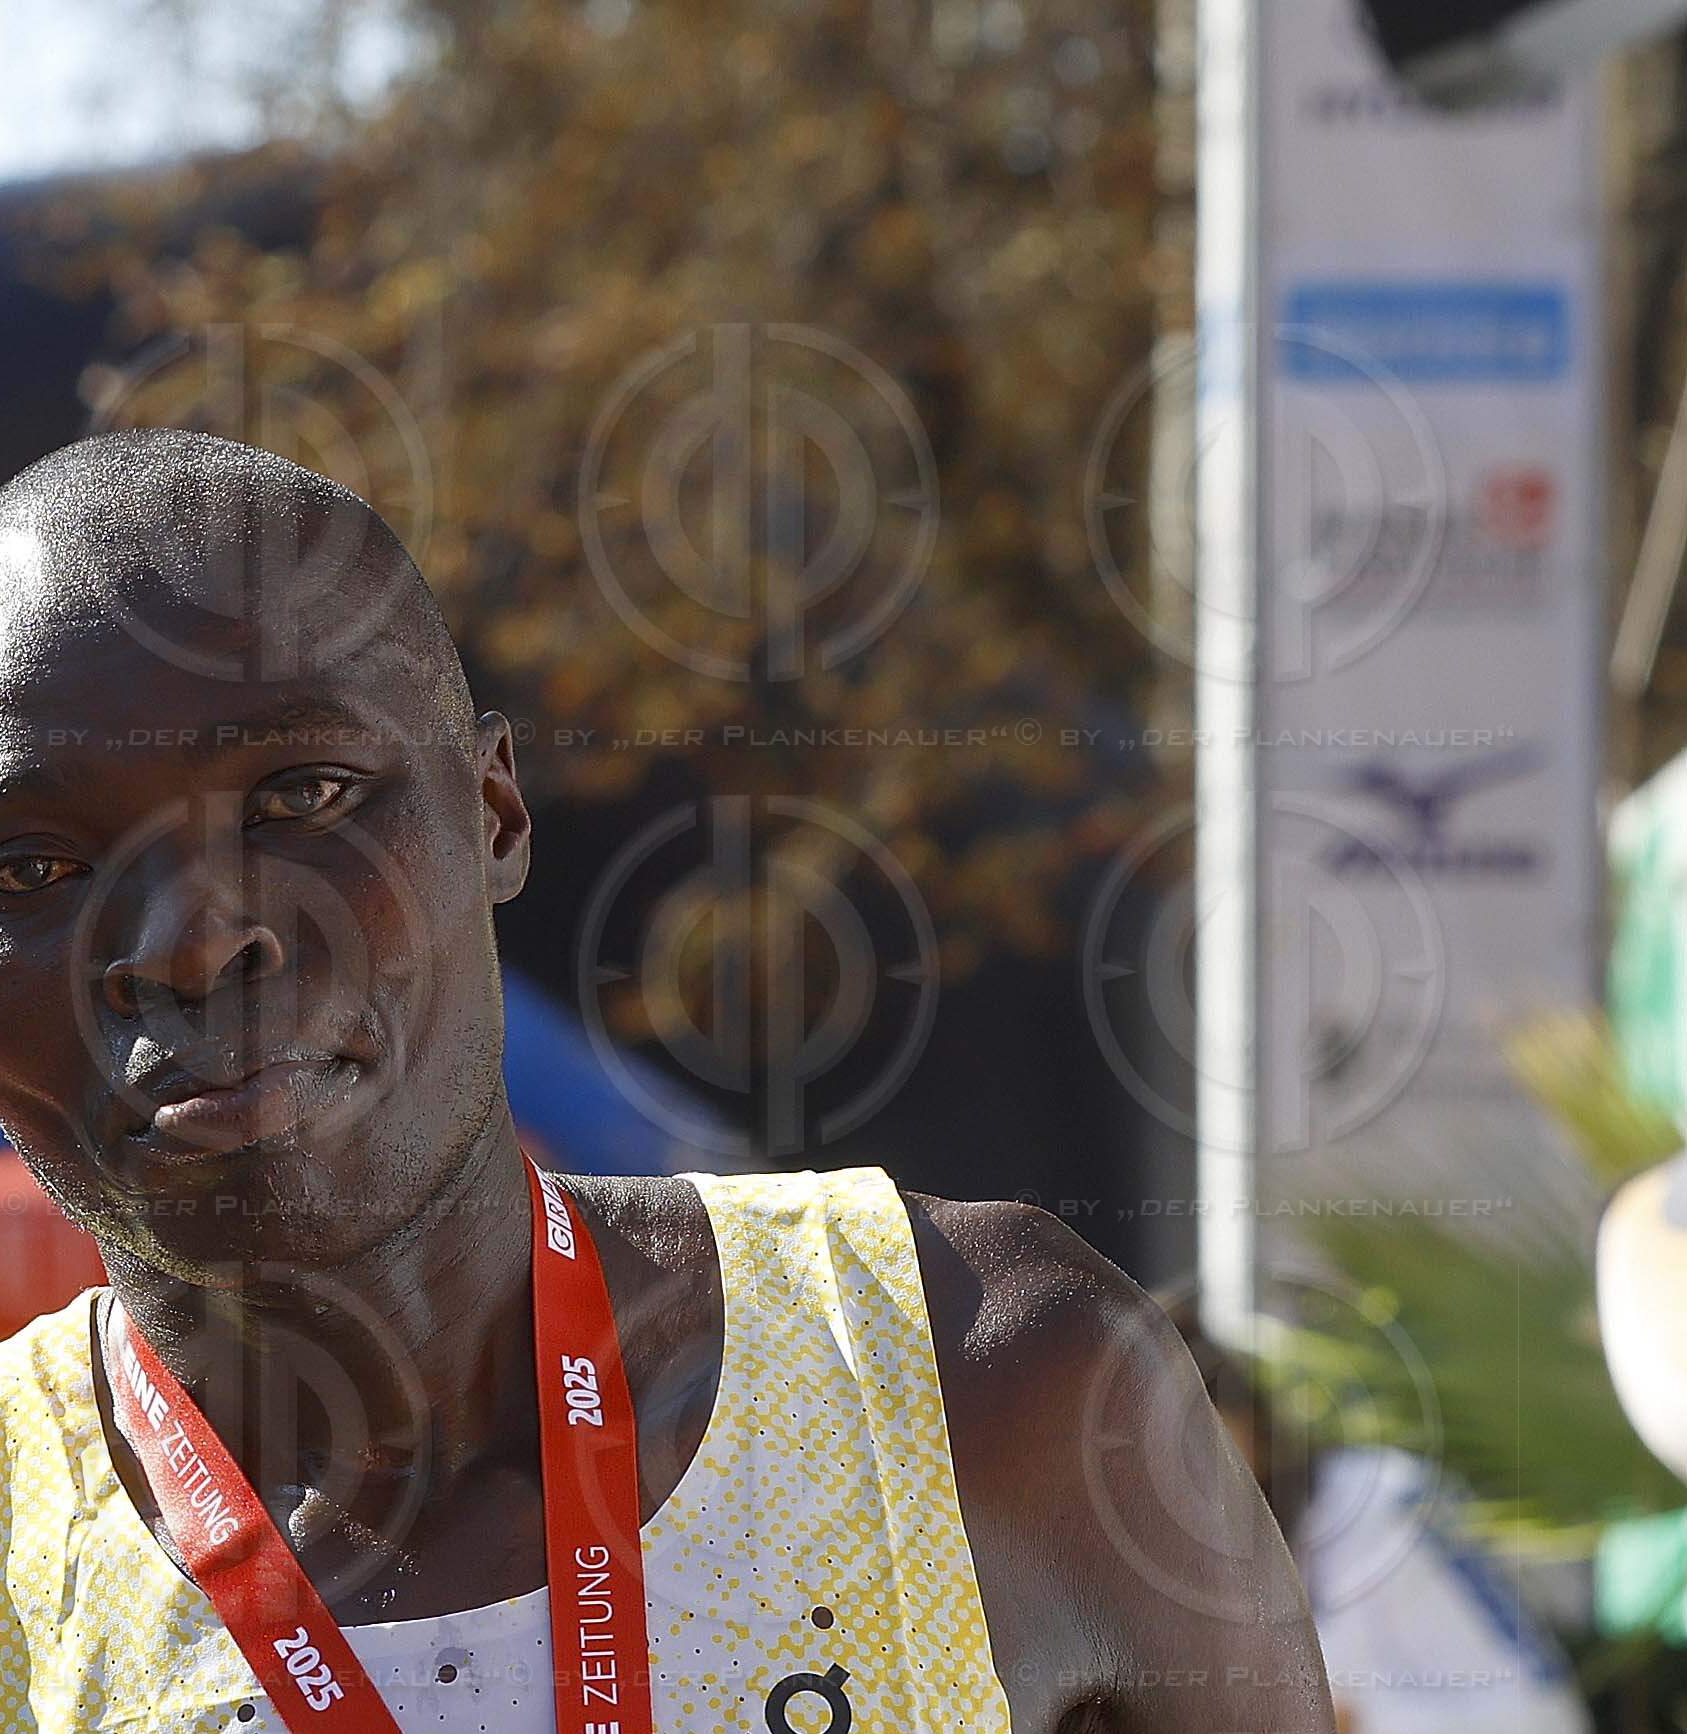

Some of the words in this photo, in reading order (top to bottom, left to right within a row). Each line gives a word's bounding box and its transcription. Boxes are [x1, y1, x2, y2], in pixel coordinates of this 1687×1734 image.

[562, 1355, 603, 1427] 2025
[160, 1420, 241, 1547] ZEITUNG
[272, 1625, 345, 1712] 2025
[574, 1546, 619, 1706] ZEITUNG
